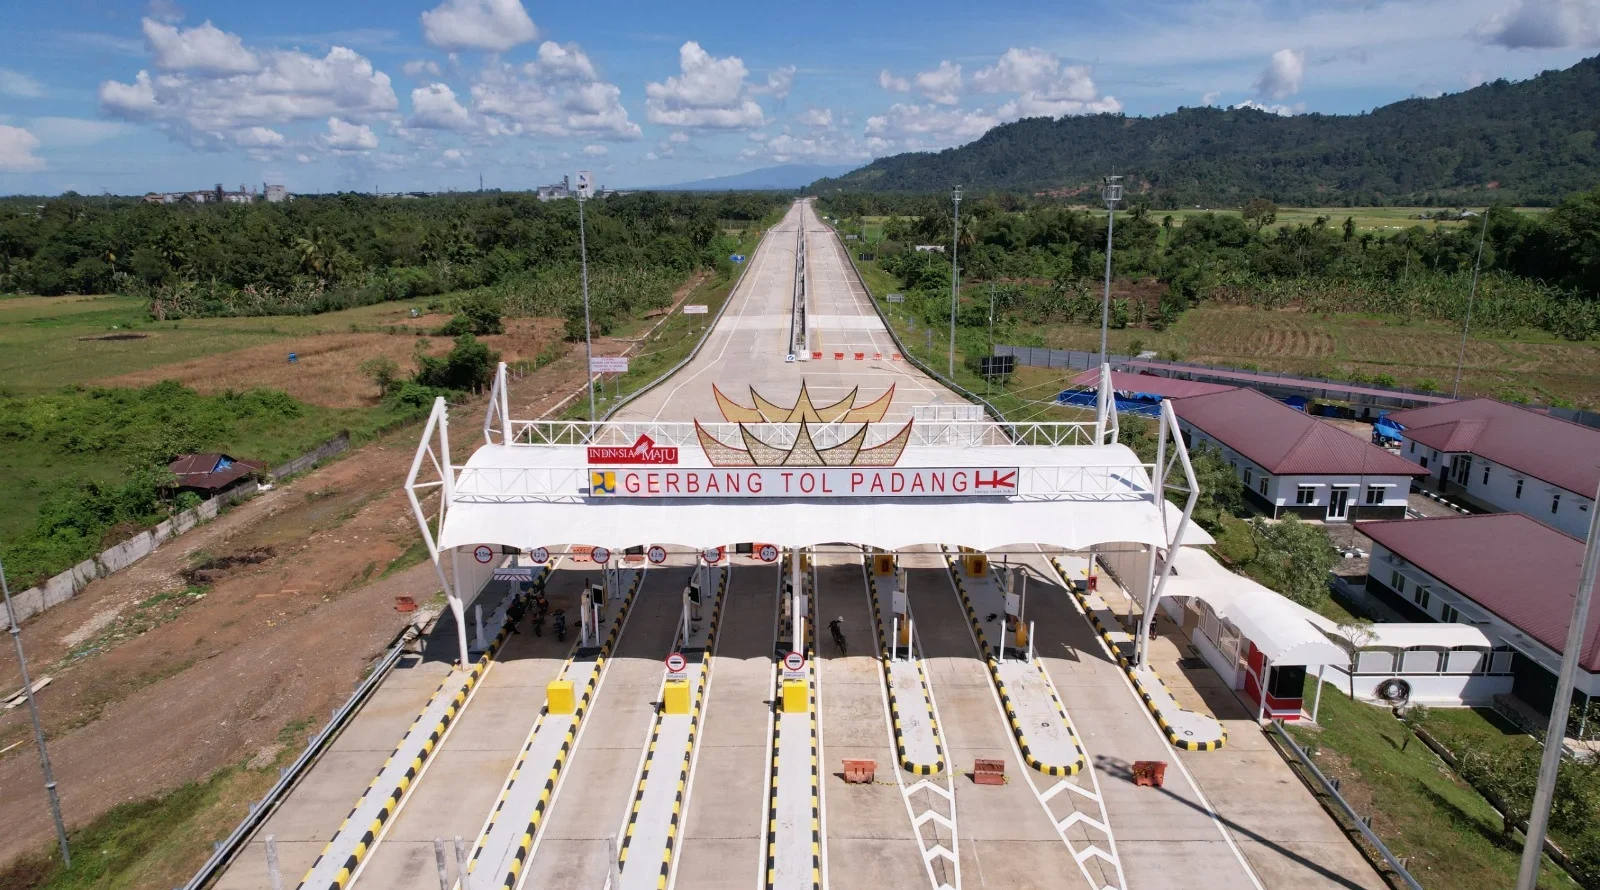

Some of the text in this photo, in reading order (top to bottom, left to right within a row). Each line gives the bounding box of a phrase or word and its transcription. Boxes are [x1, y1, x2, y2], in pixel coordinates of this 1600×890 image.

[641, 449, 676, 463] MAJU
[624, 472, 763, 494] GERBANG
[781, 472, 833, 493] TOL
[851, 472, 968, 493] PADANG
